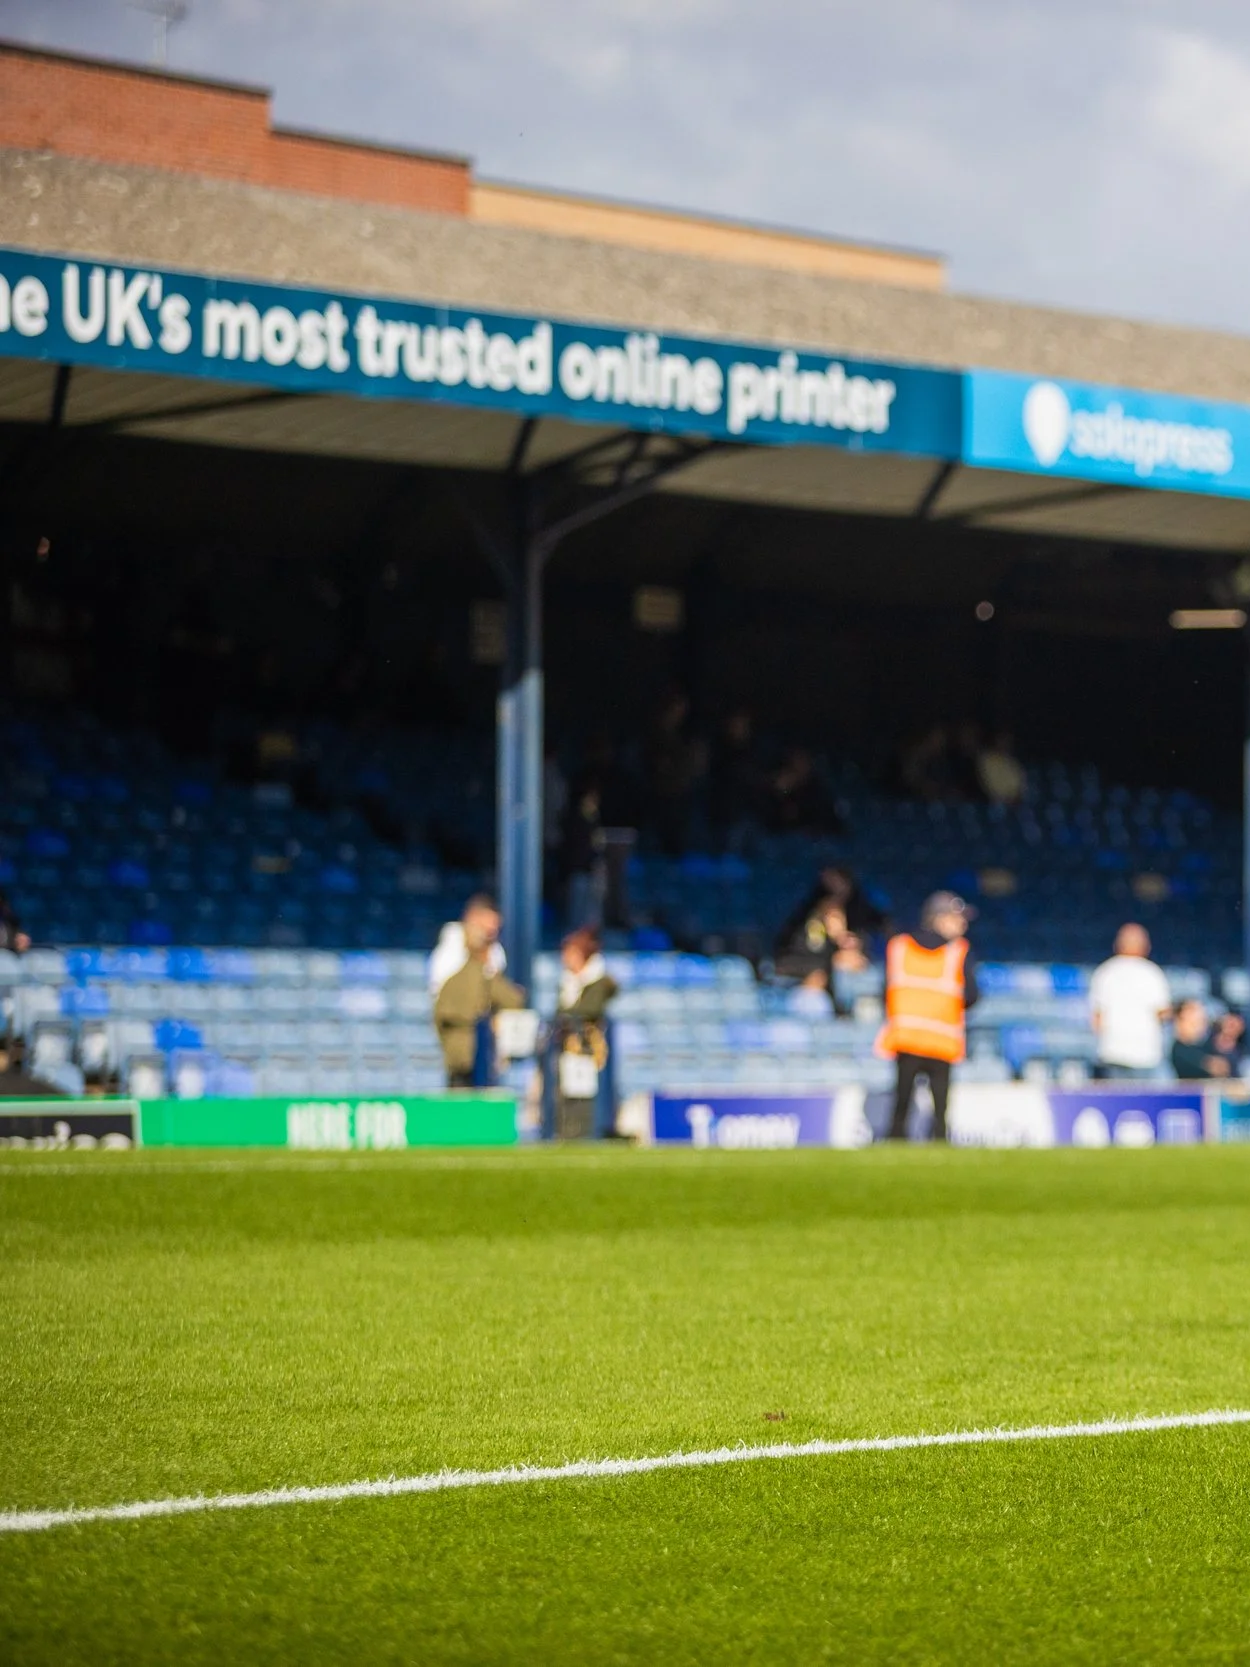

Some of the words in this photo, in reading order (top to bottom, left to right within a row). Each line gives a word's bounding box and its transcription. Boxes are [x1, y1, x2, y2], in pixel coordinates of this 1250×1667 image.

[62, 262, 192, 353] UK's
[203, 300, 350, 370] most
[353, 304, 553, 396] trusted
[558, 332, 723, 415] online
[726, 350, 896, 435] printer
